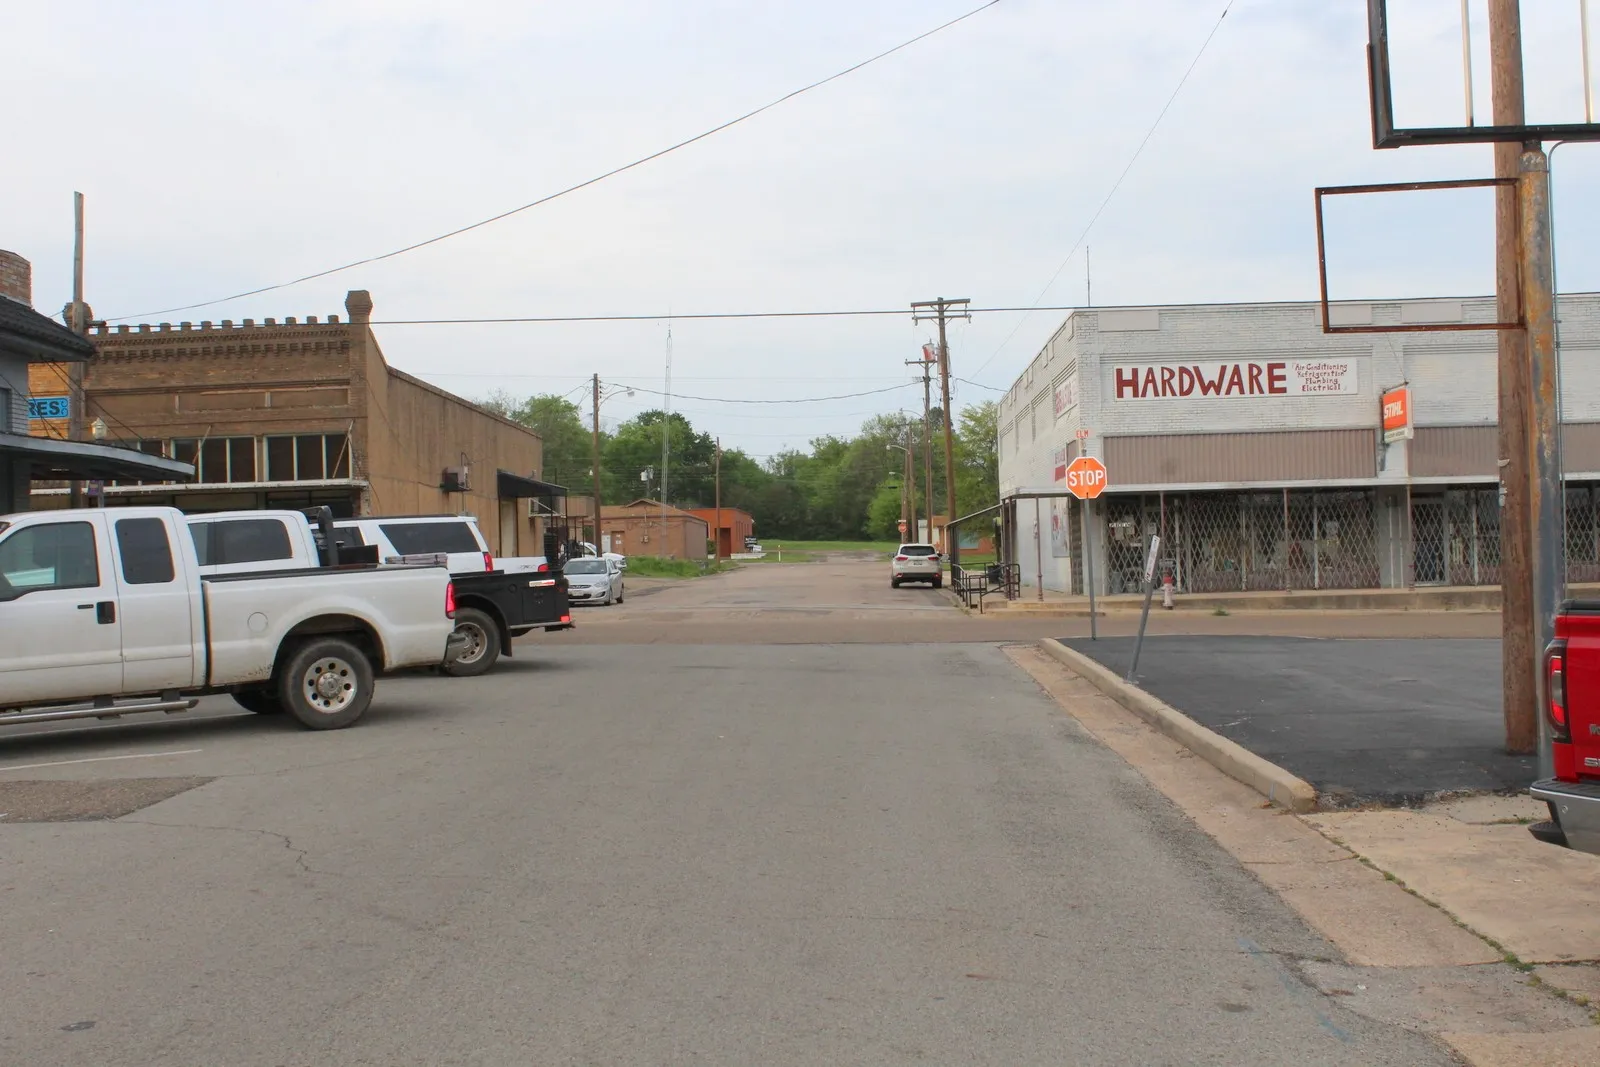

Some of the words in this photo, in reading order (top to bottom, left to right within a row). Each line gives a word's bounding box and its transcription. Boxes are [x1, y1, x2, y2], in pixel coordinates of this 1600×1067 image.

[1306, 363, 1348, 373] Conditioning
[1115, 362, 1287, 398] HARDWARE
[1305, 377, 1339, 385] Plumbing
[1301, 383, 1341, 392] Electrical
[1383, 400, 1404, 419] STIHL
[1075, 429, 1089, 438] ELM
[1069, 470, 1104, 487] STOP
